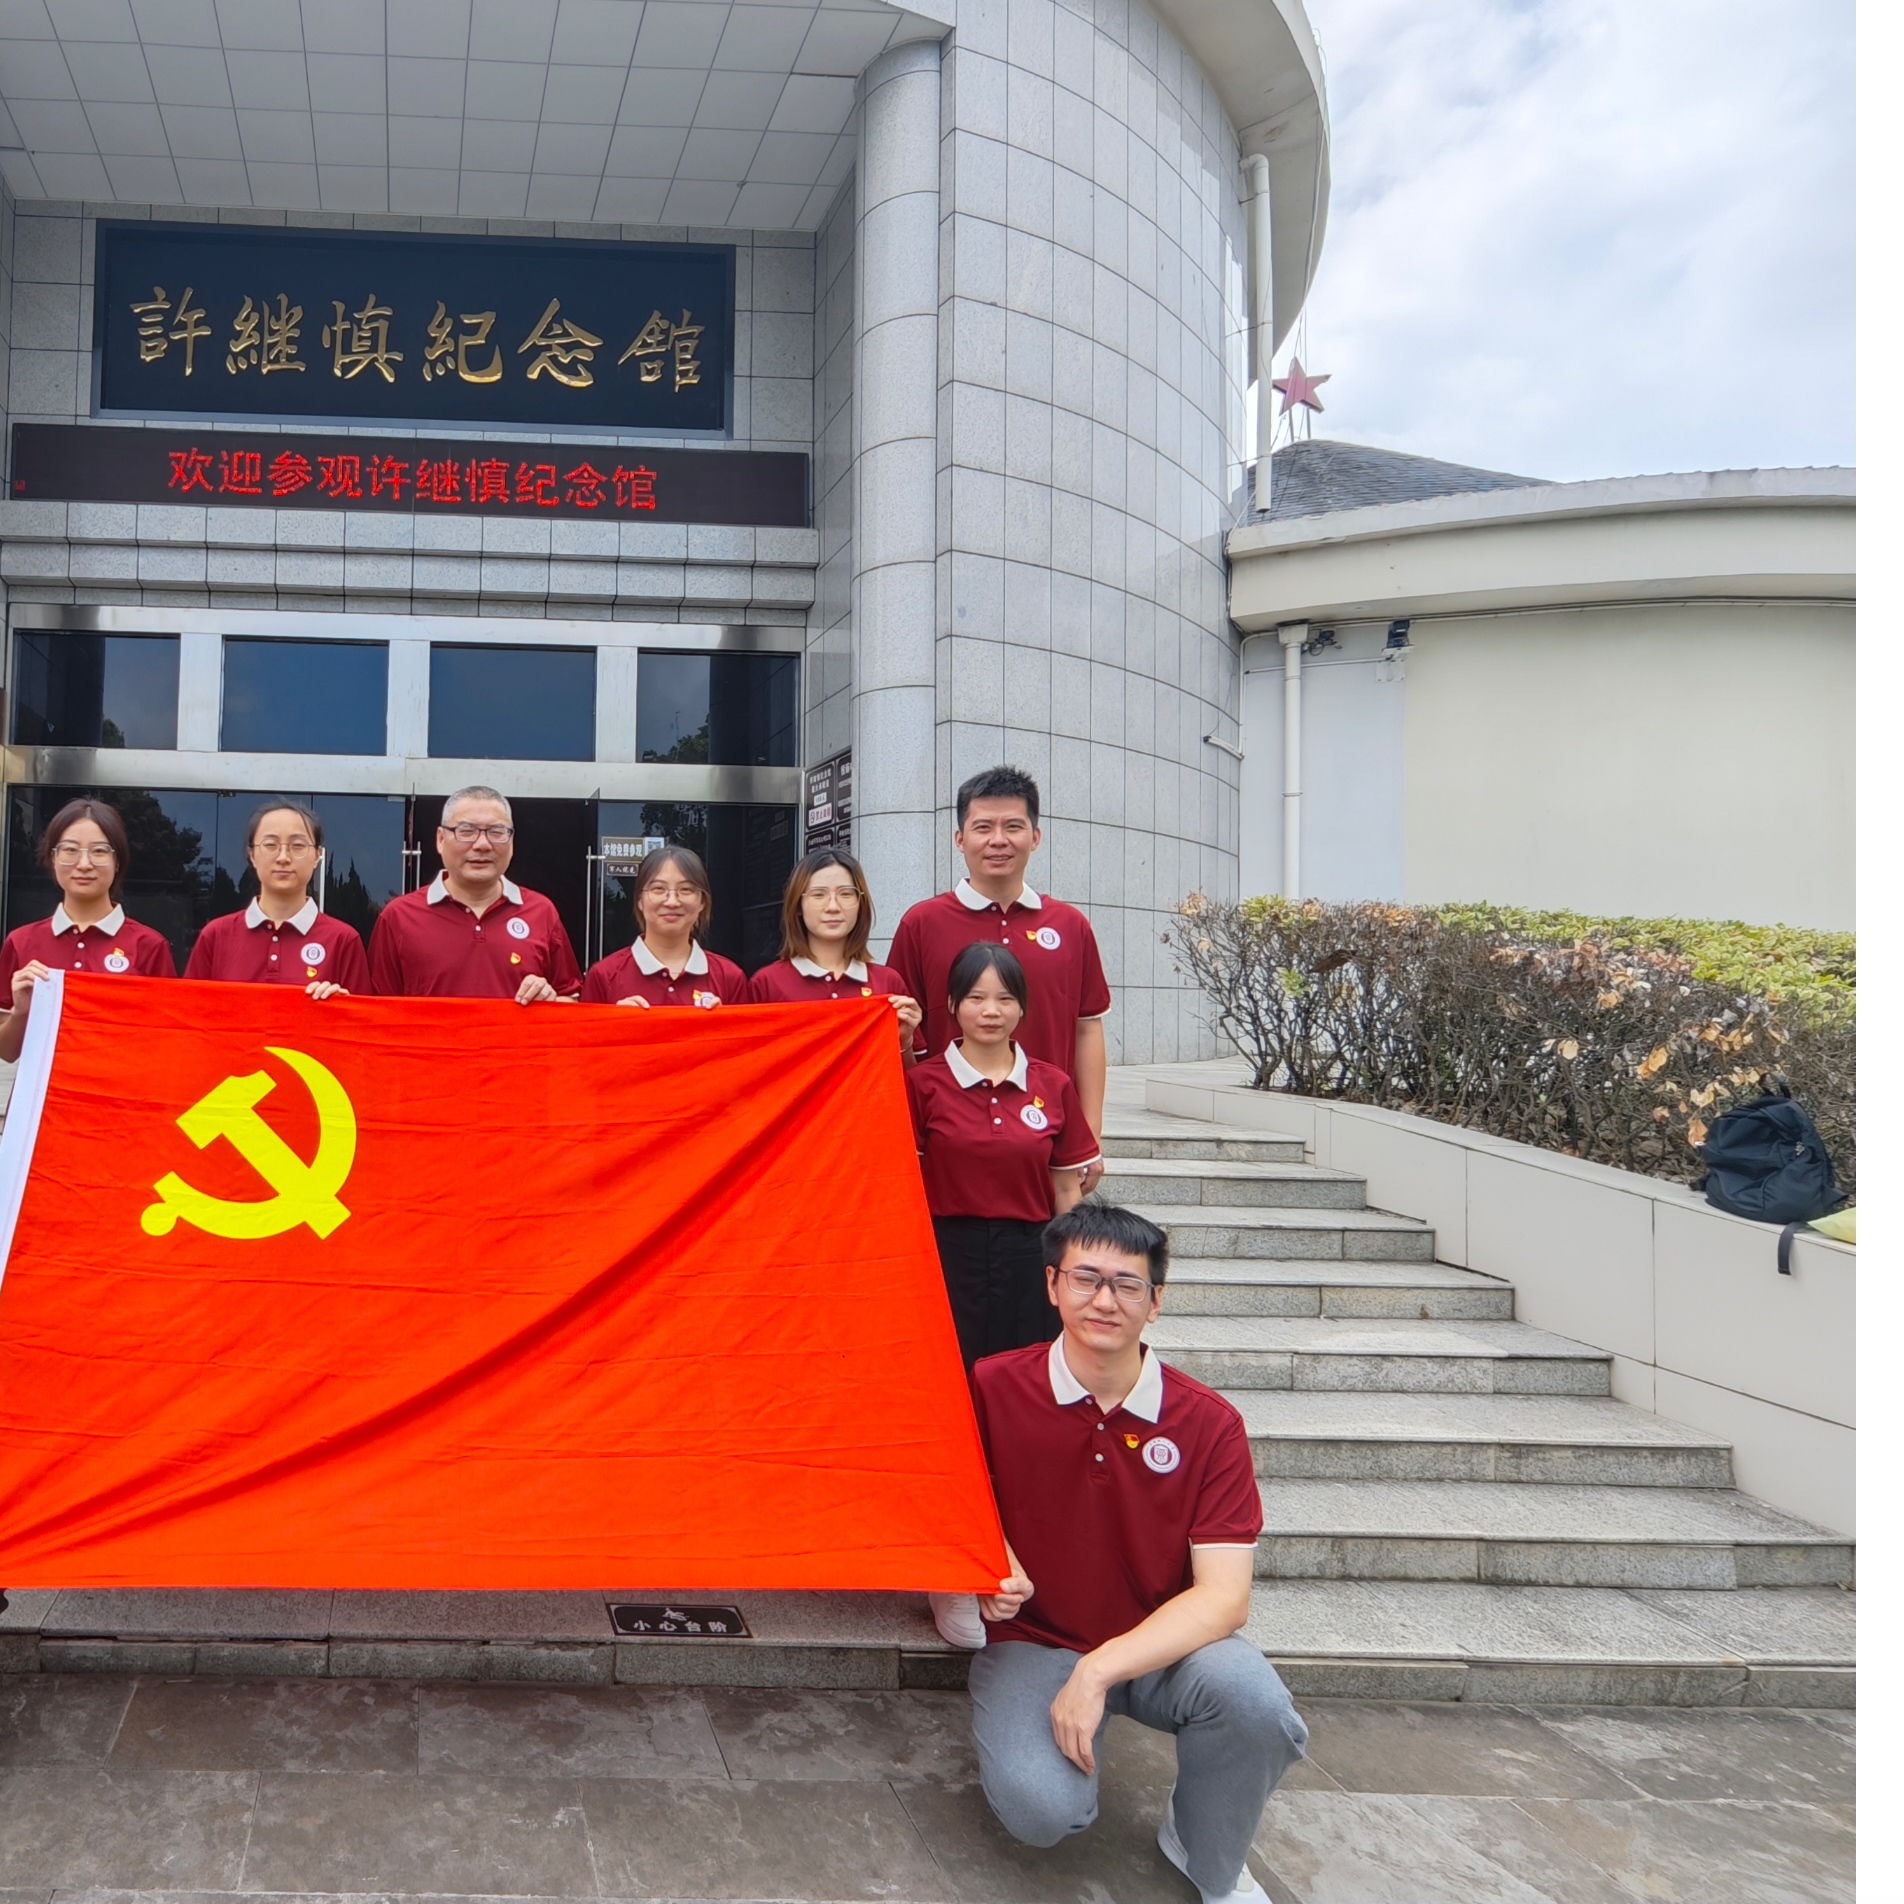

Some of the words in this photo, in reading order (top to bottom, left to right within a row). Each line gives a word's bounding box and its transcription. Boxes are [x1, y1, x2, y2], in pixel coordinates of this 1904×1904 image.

[167, 449, 658, 510] 欢迎参观许继慎纪念馆
[633, 1620, 728, 1632] 小心台阶
